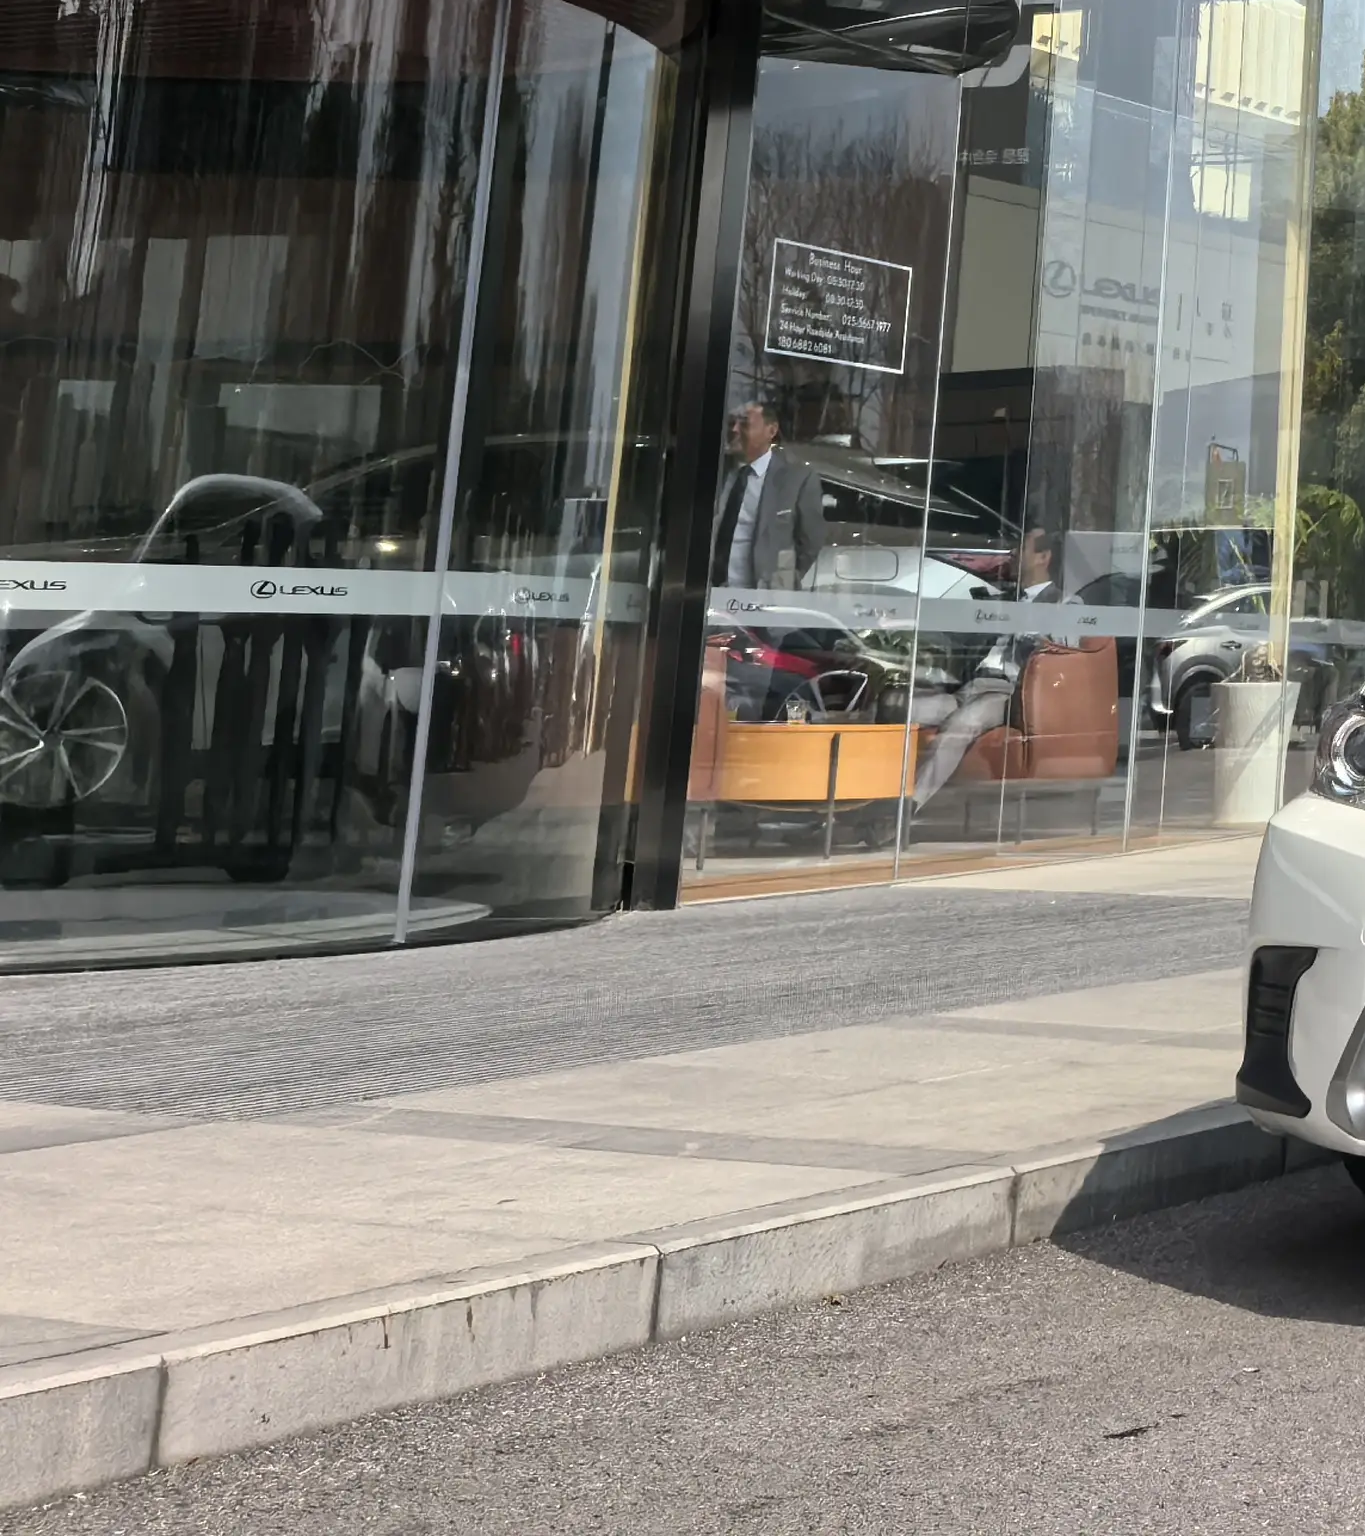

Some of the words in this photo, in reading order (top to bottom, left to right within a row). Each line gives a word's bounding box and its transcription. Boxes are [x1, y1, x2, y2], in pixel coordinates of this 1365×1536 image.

[809, 252, 841, 269] Business
[844, 260, 863, 276] Hour
[789, 322, 806, 335] Hour
[0, 579, 67, 591] EXUS
[279, 585, 348, 597] LEXUS
